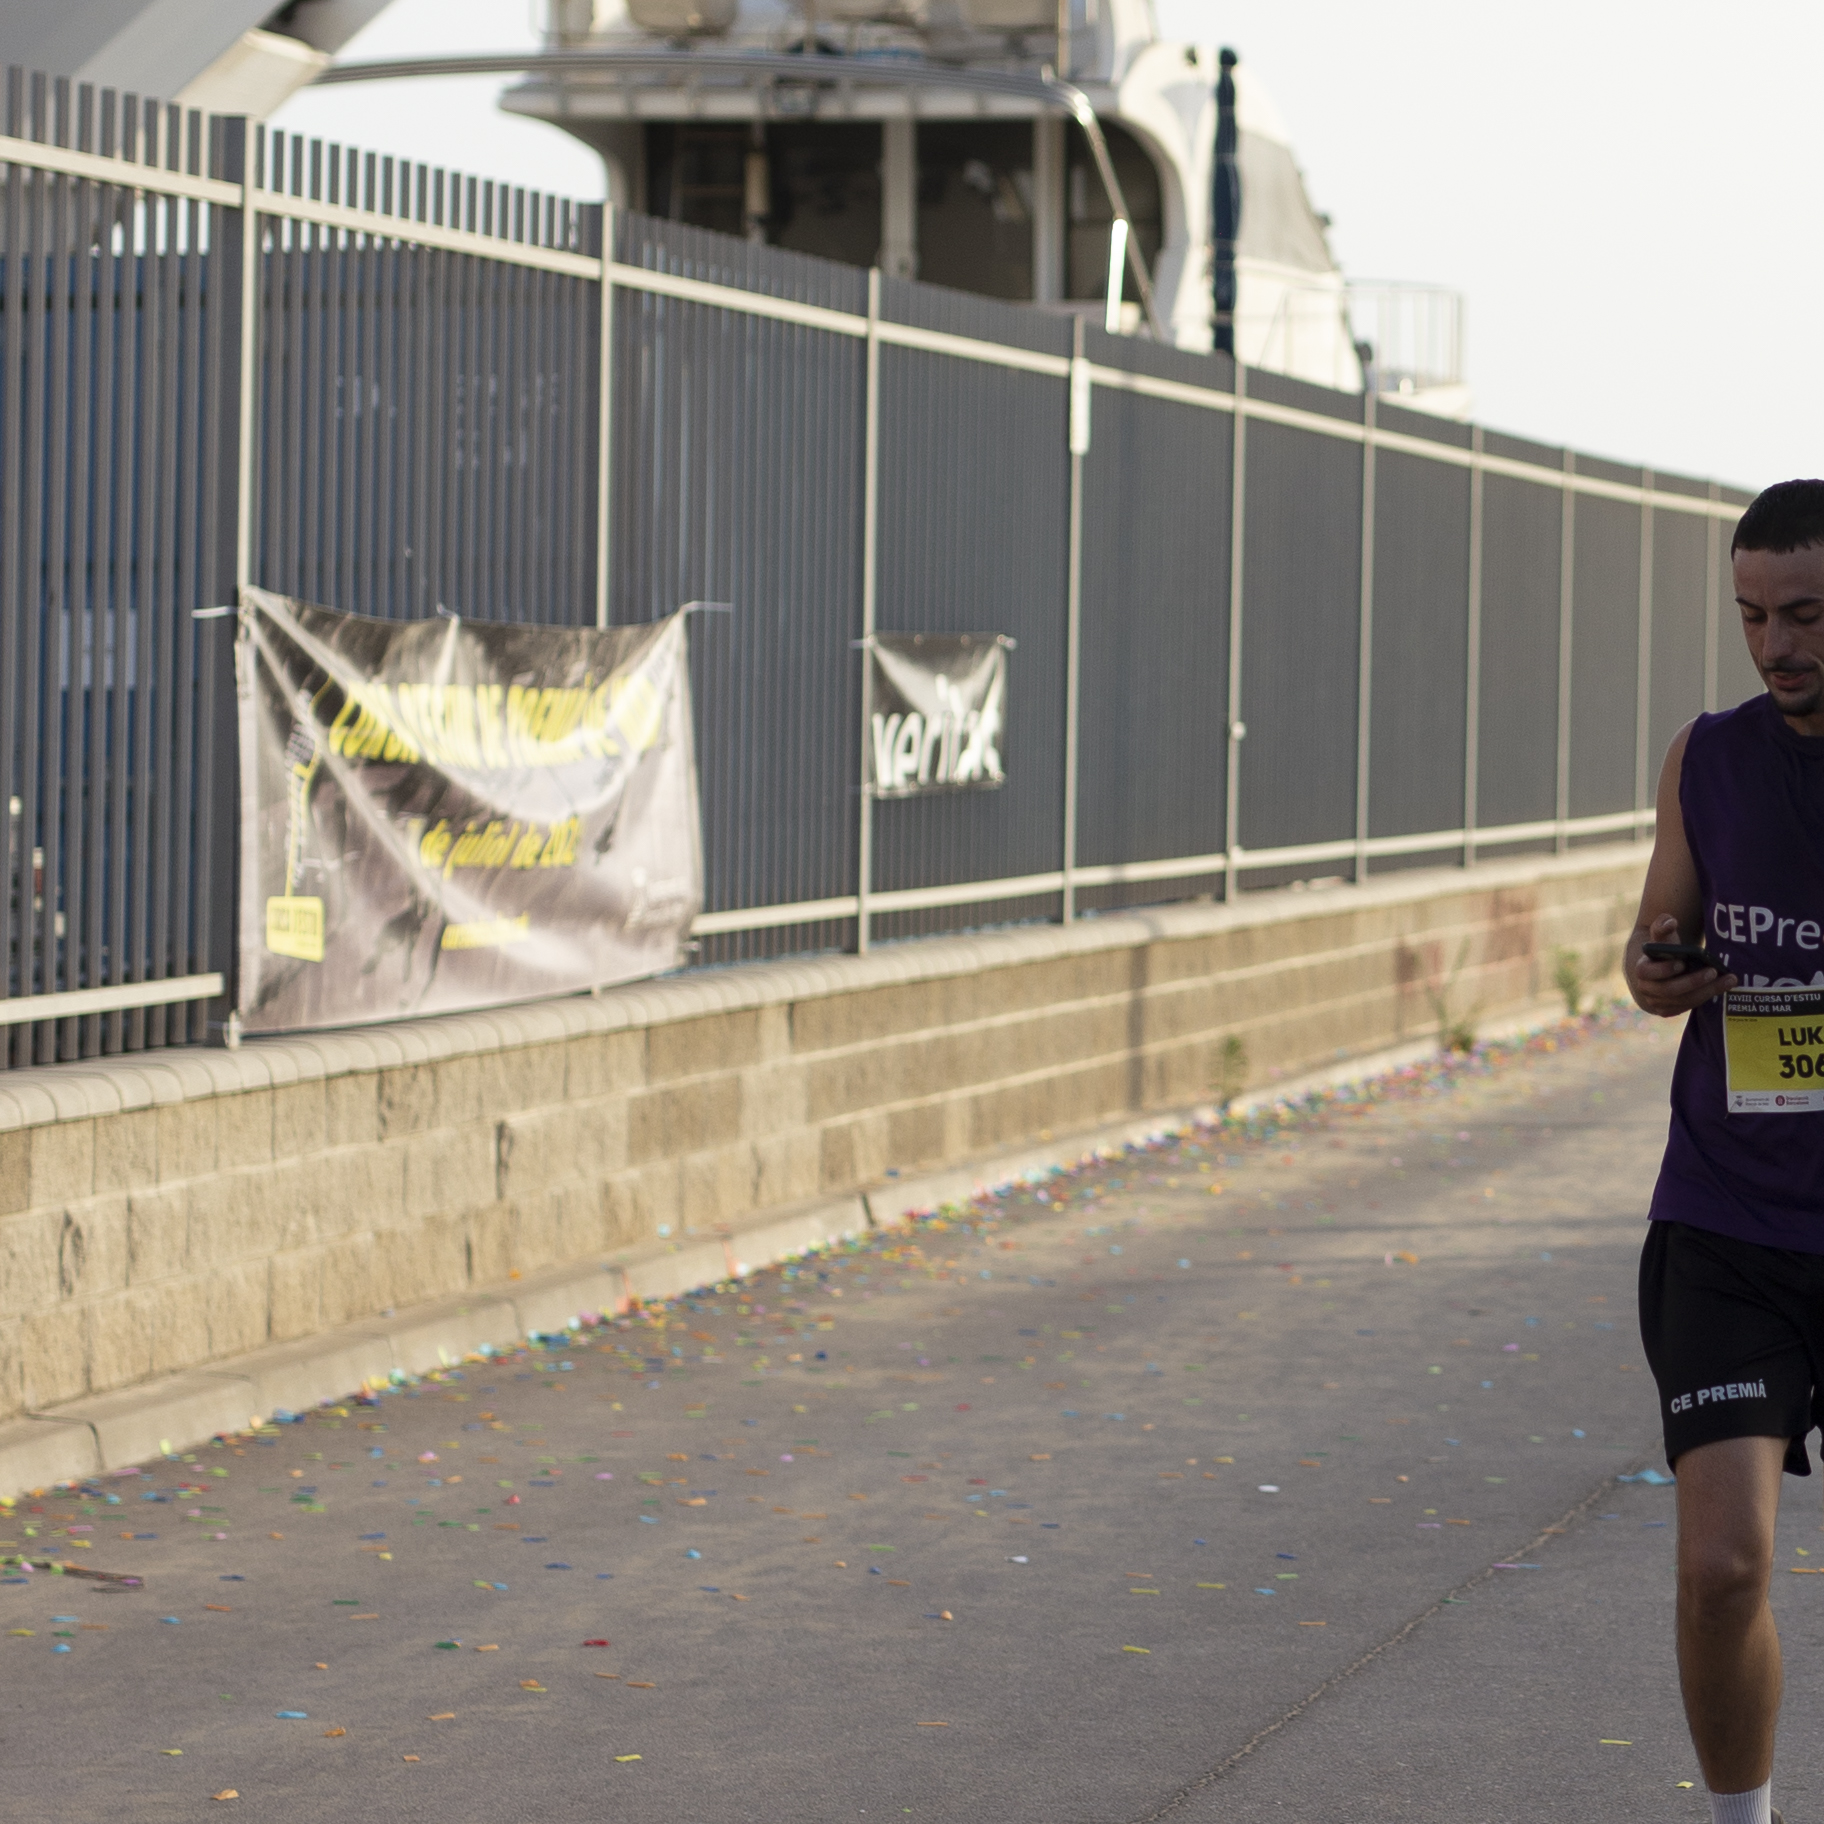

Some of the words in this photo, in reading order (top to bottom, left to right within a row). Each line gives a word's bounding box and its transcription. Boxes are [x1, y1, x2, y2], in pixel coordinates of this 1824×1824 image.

[1754, 994, 1782, 1003] CURSA
[1784, 993, 1821, 1002] D'ESTIU
[1727, 1003, 1757, 1012] PREMIÀ
[1759, 1004, 1770, 1013] DE
[1772, 1004, 1792, 1012] MAR
[1778, 1026, 1824, 1047] LUK
[1670, 1392, 1693, 1414] CE
[1697, 1378, 1767, 1406] PREMIÁ
